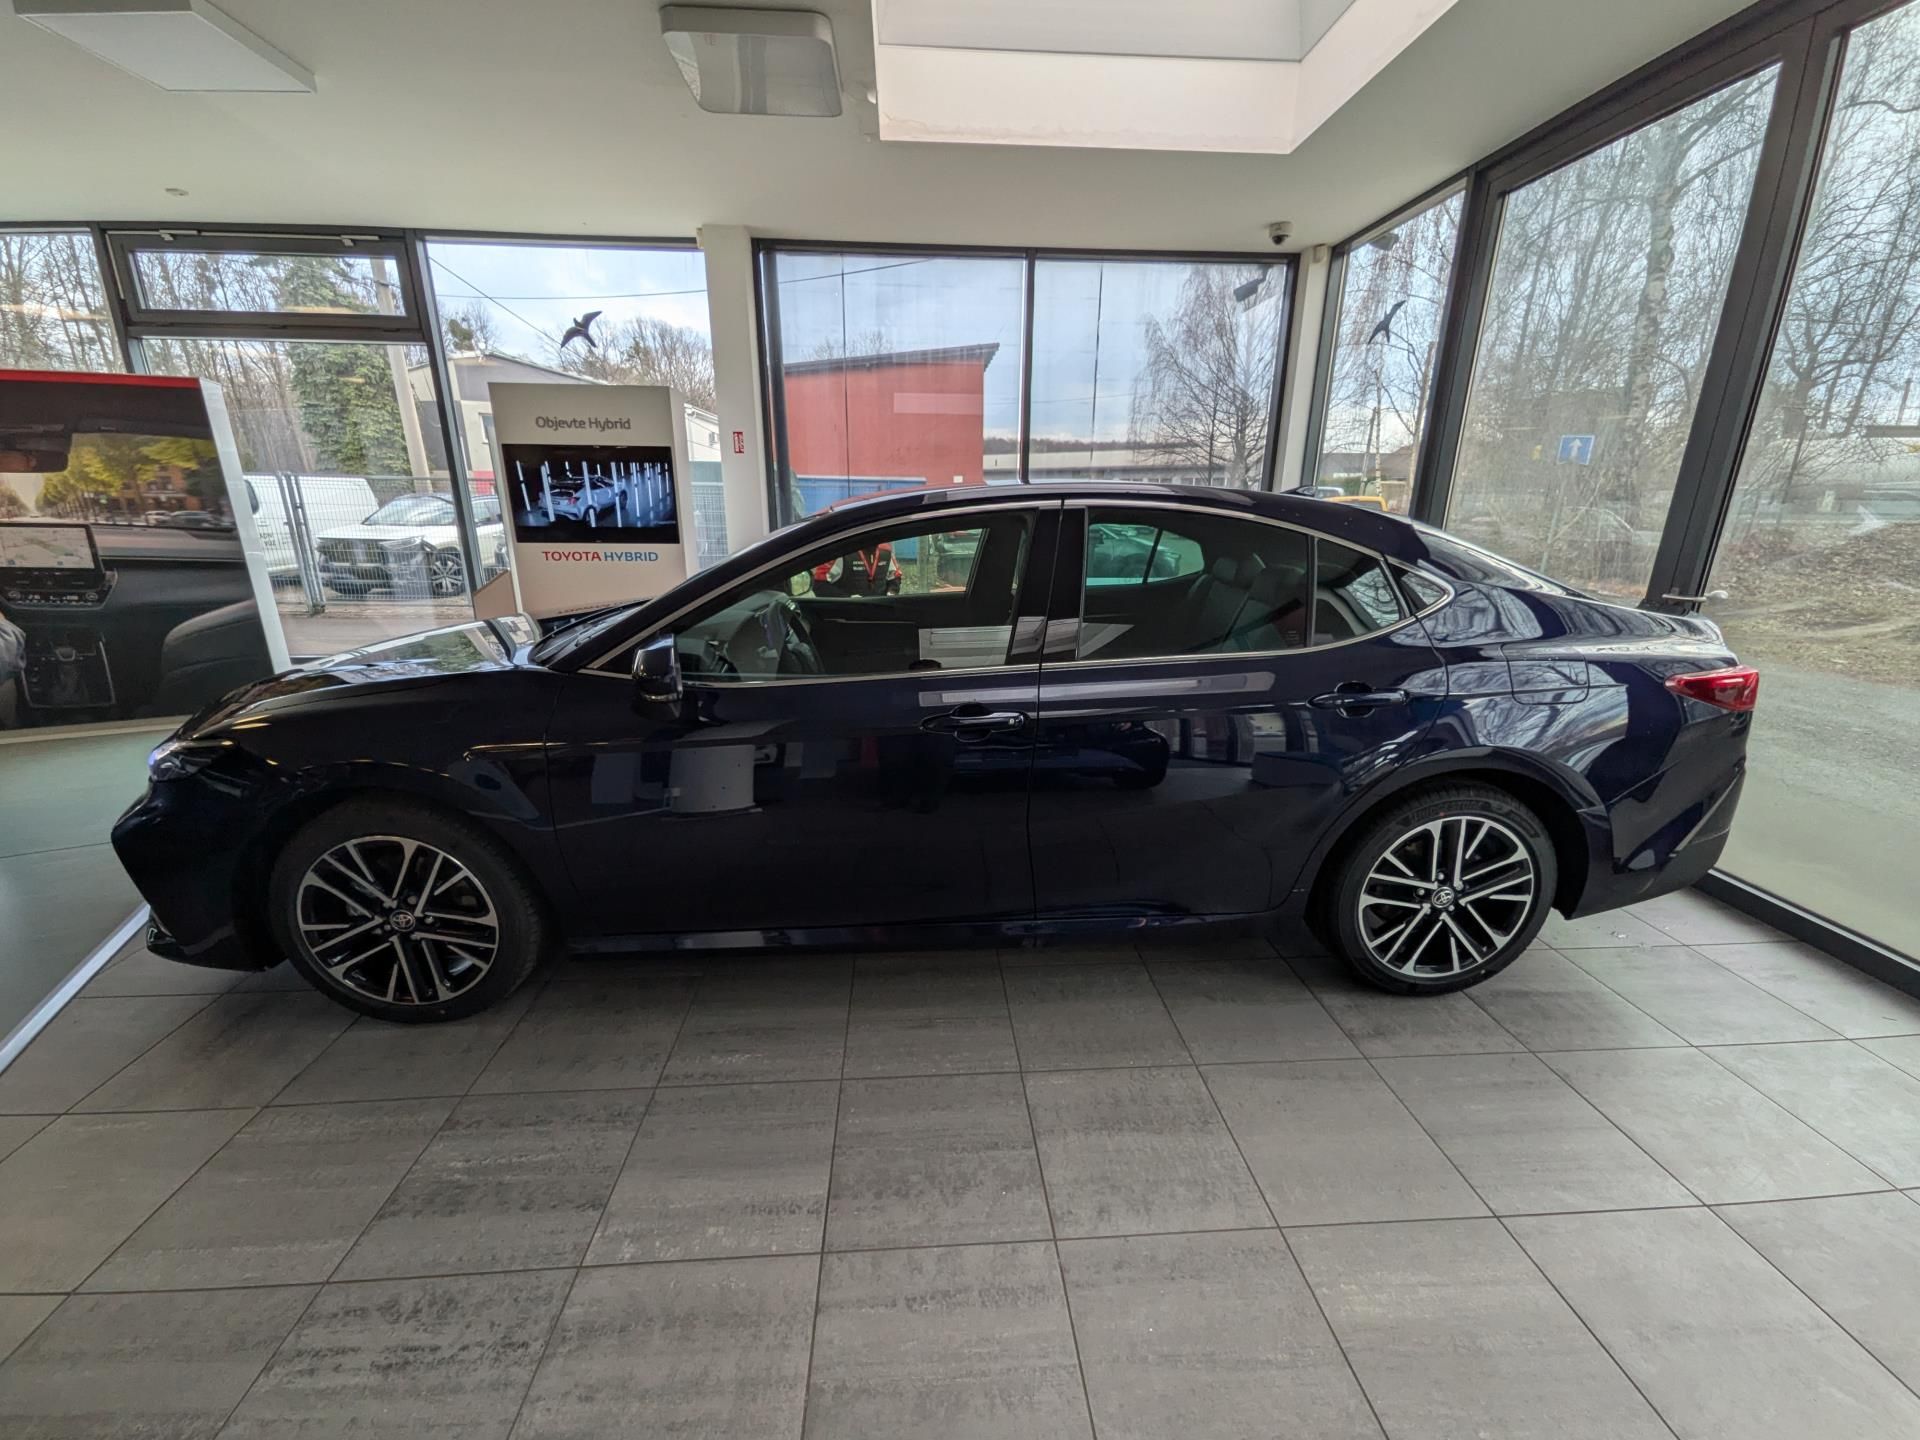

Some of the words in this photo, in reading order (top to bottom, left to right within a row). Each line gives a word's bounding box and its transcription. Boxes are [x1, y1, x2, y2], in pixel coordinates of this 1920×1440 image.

[535, 416, 586, 431] Objevte
[588, 417, 631, 432] Hybrid
[542, 551, 602, 562] TOYOTA
[603, 551, 659, 562] HYBRID
